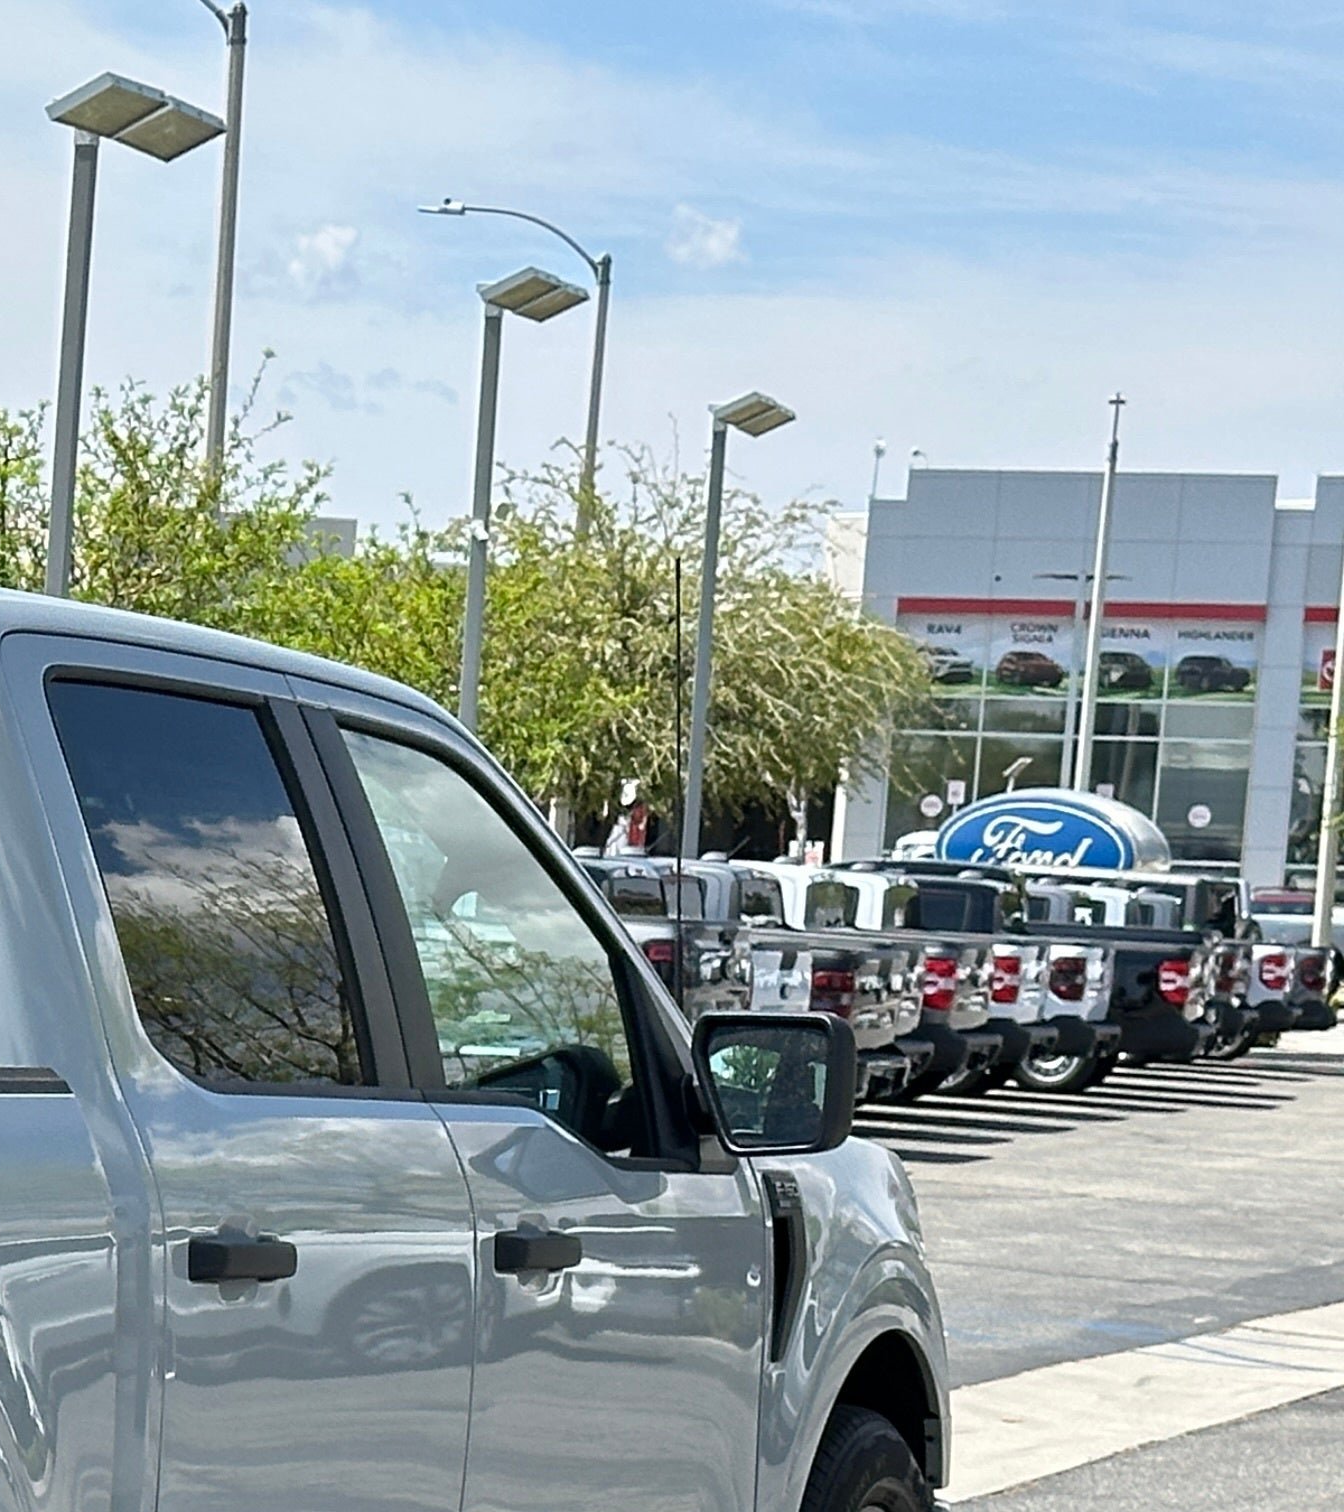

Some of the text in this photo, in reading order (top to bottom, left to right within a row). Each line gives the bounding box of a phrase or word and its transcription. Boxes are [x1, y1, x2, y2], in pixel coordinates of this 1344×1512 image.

[926, 623, 962, 635] RAV4
[1010, 622, 1059, 634] CROWN
[1177, 630, 1255, 642] HIGHLANDER
